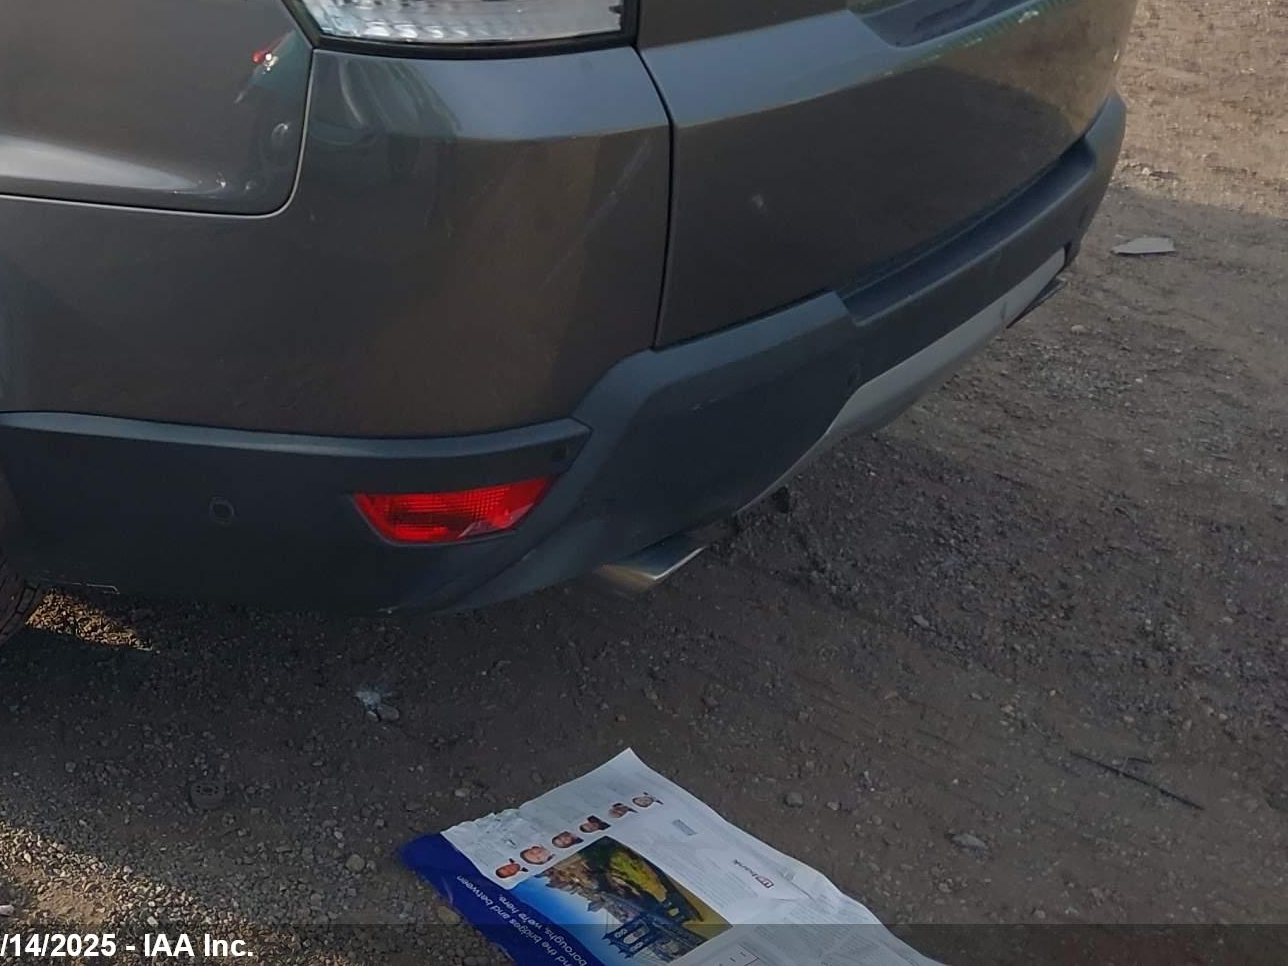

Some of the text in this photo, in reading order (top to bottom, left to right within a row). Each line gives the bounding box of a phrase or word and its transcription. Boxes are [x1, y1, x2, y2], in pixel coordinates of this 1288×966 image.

[456, 875, 492, 907] between
[491, 904, 509, 920] and
[541, 940, 559, 957] the
